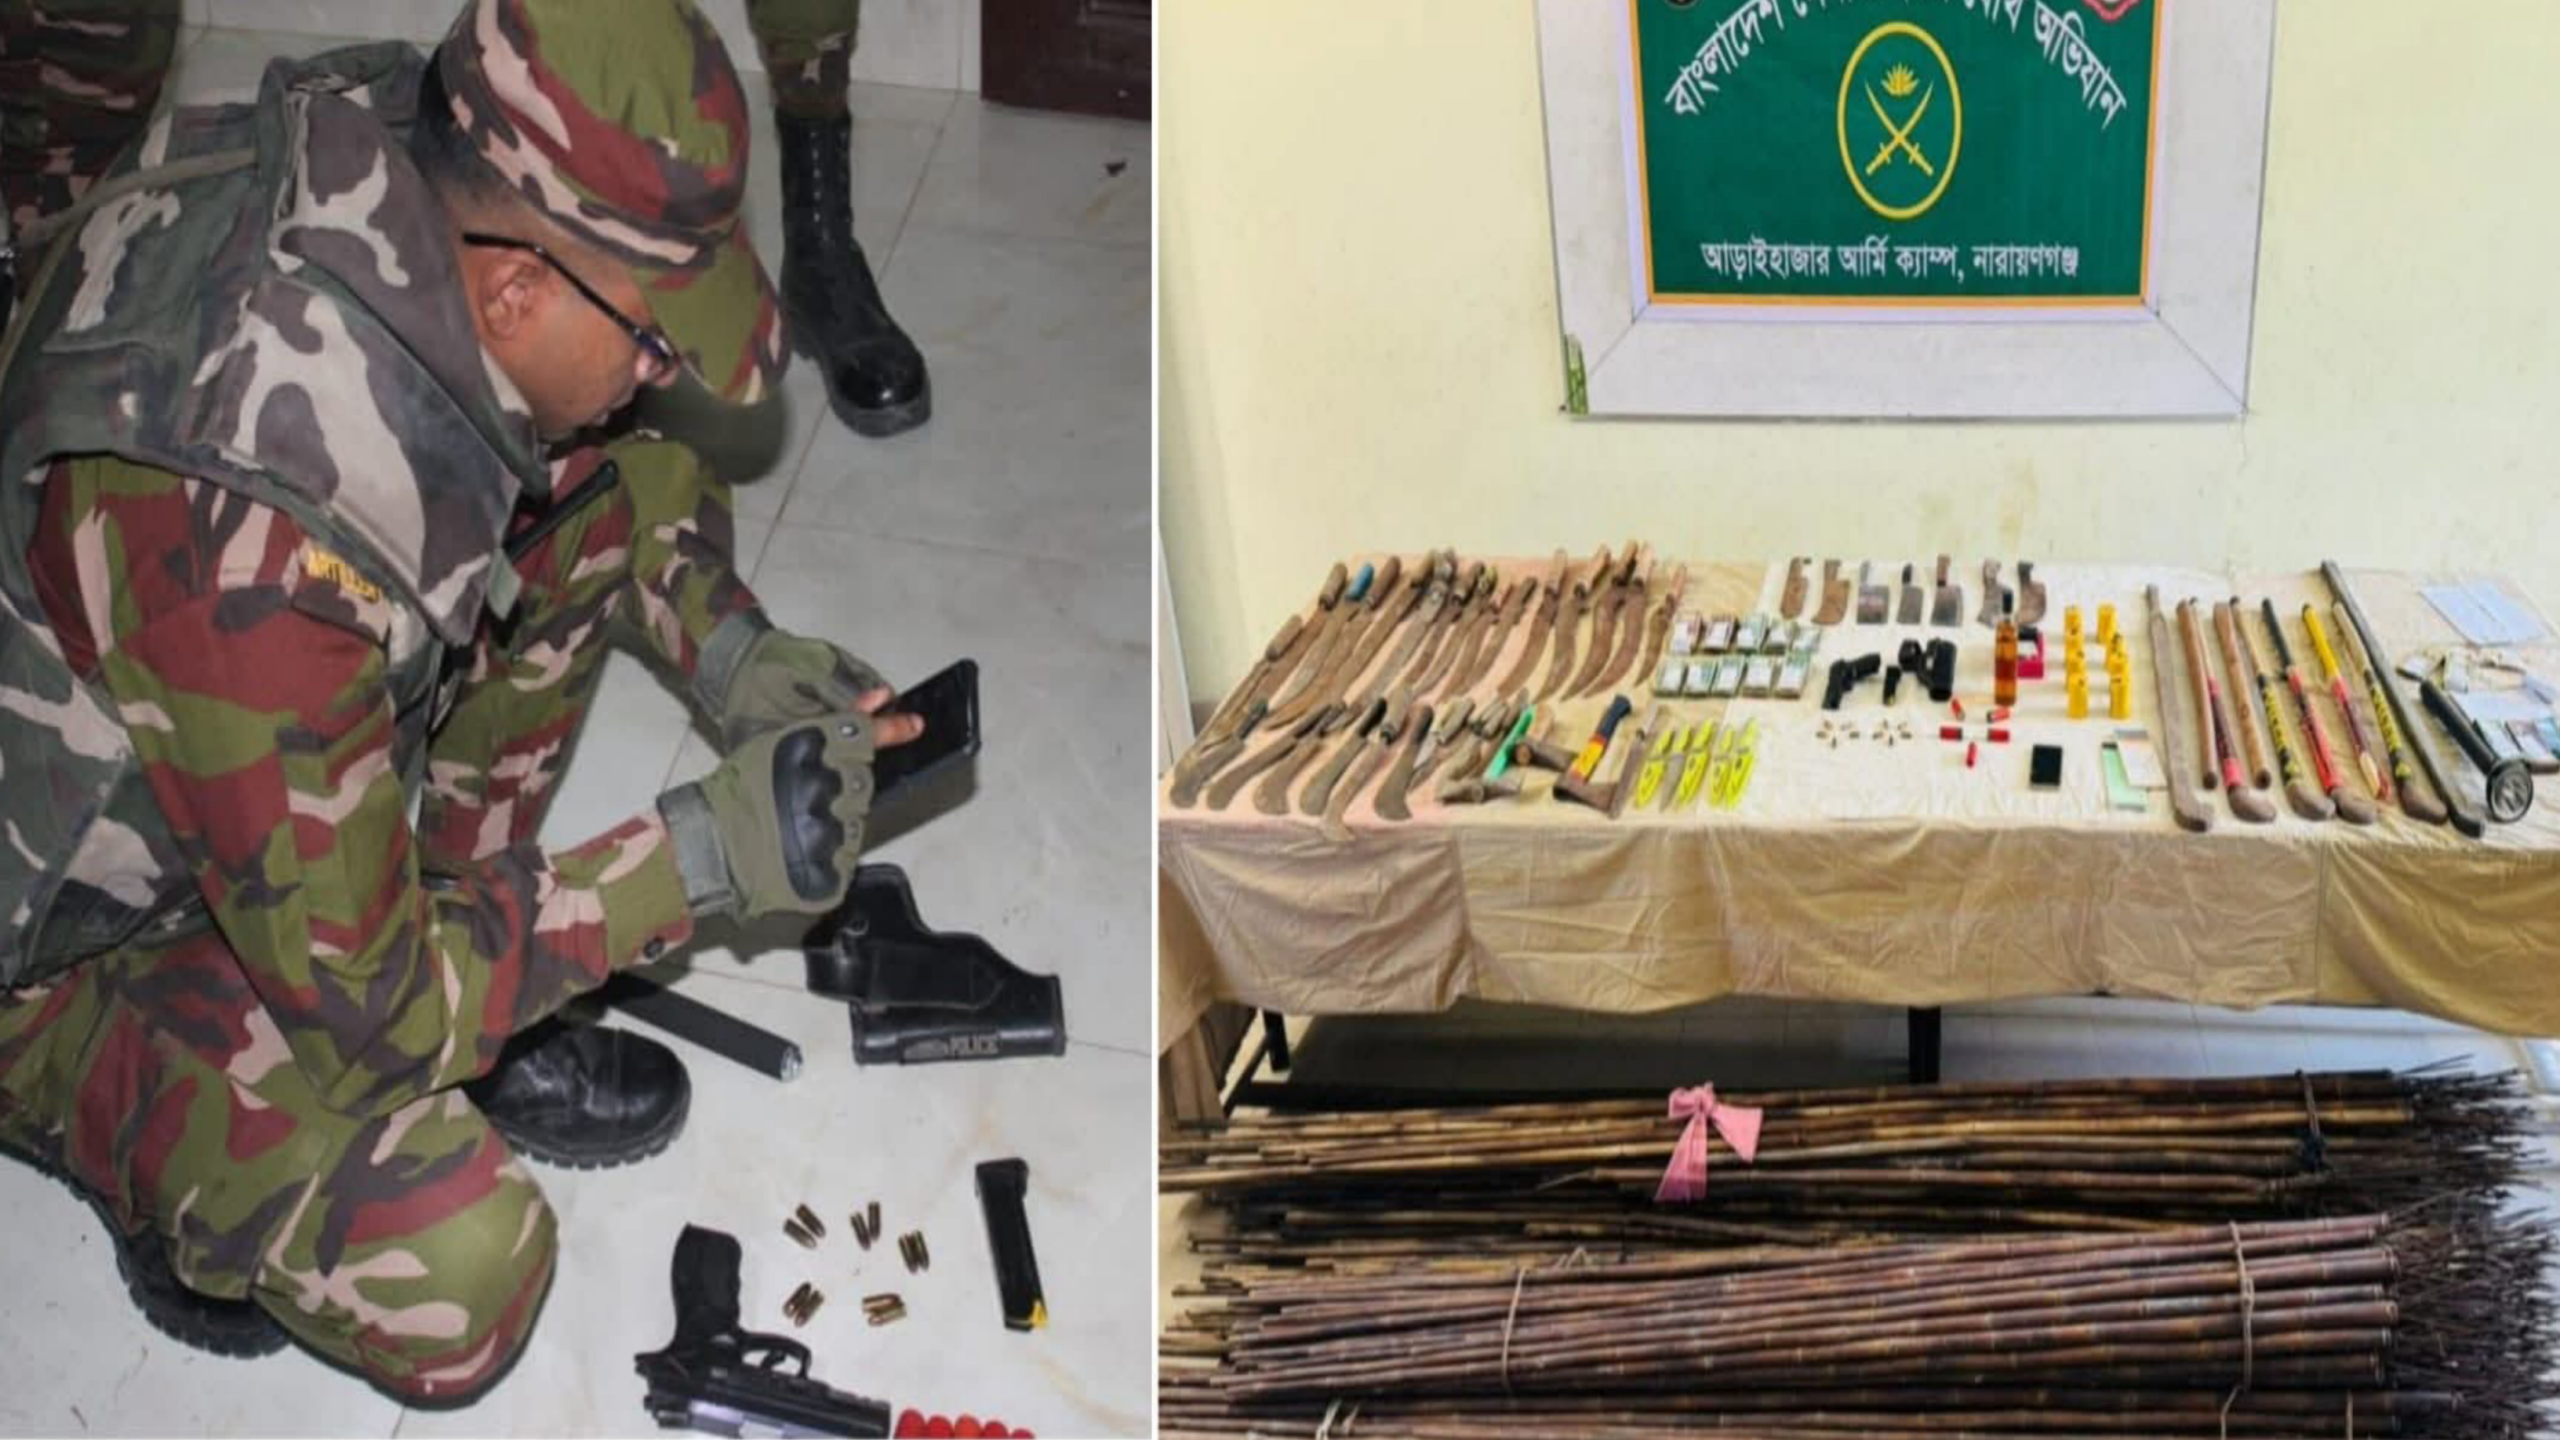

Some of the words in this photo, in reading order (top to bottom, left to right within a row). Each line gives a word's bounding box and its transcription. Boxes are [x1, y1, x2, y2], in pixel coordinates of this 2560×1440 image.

[1664, 0, 1785, 116] বাংলাদেশ
[2033, 0, 2127, 130] অভিযান
[1702, 238, 1830, 279] আড়াইহাজার
[1838, 235, 1887, 273] আর্মি
[1895, 245, 1964, 281] ক্যাম্প,
[1974, 245, 2078, 277] নারায়ণগঞ্জ
[949, 1035, 1001, 1057] POLICE
